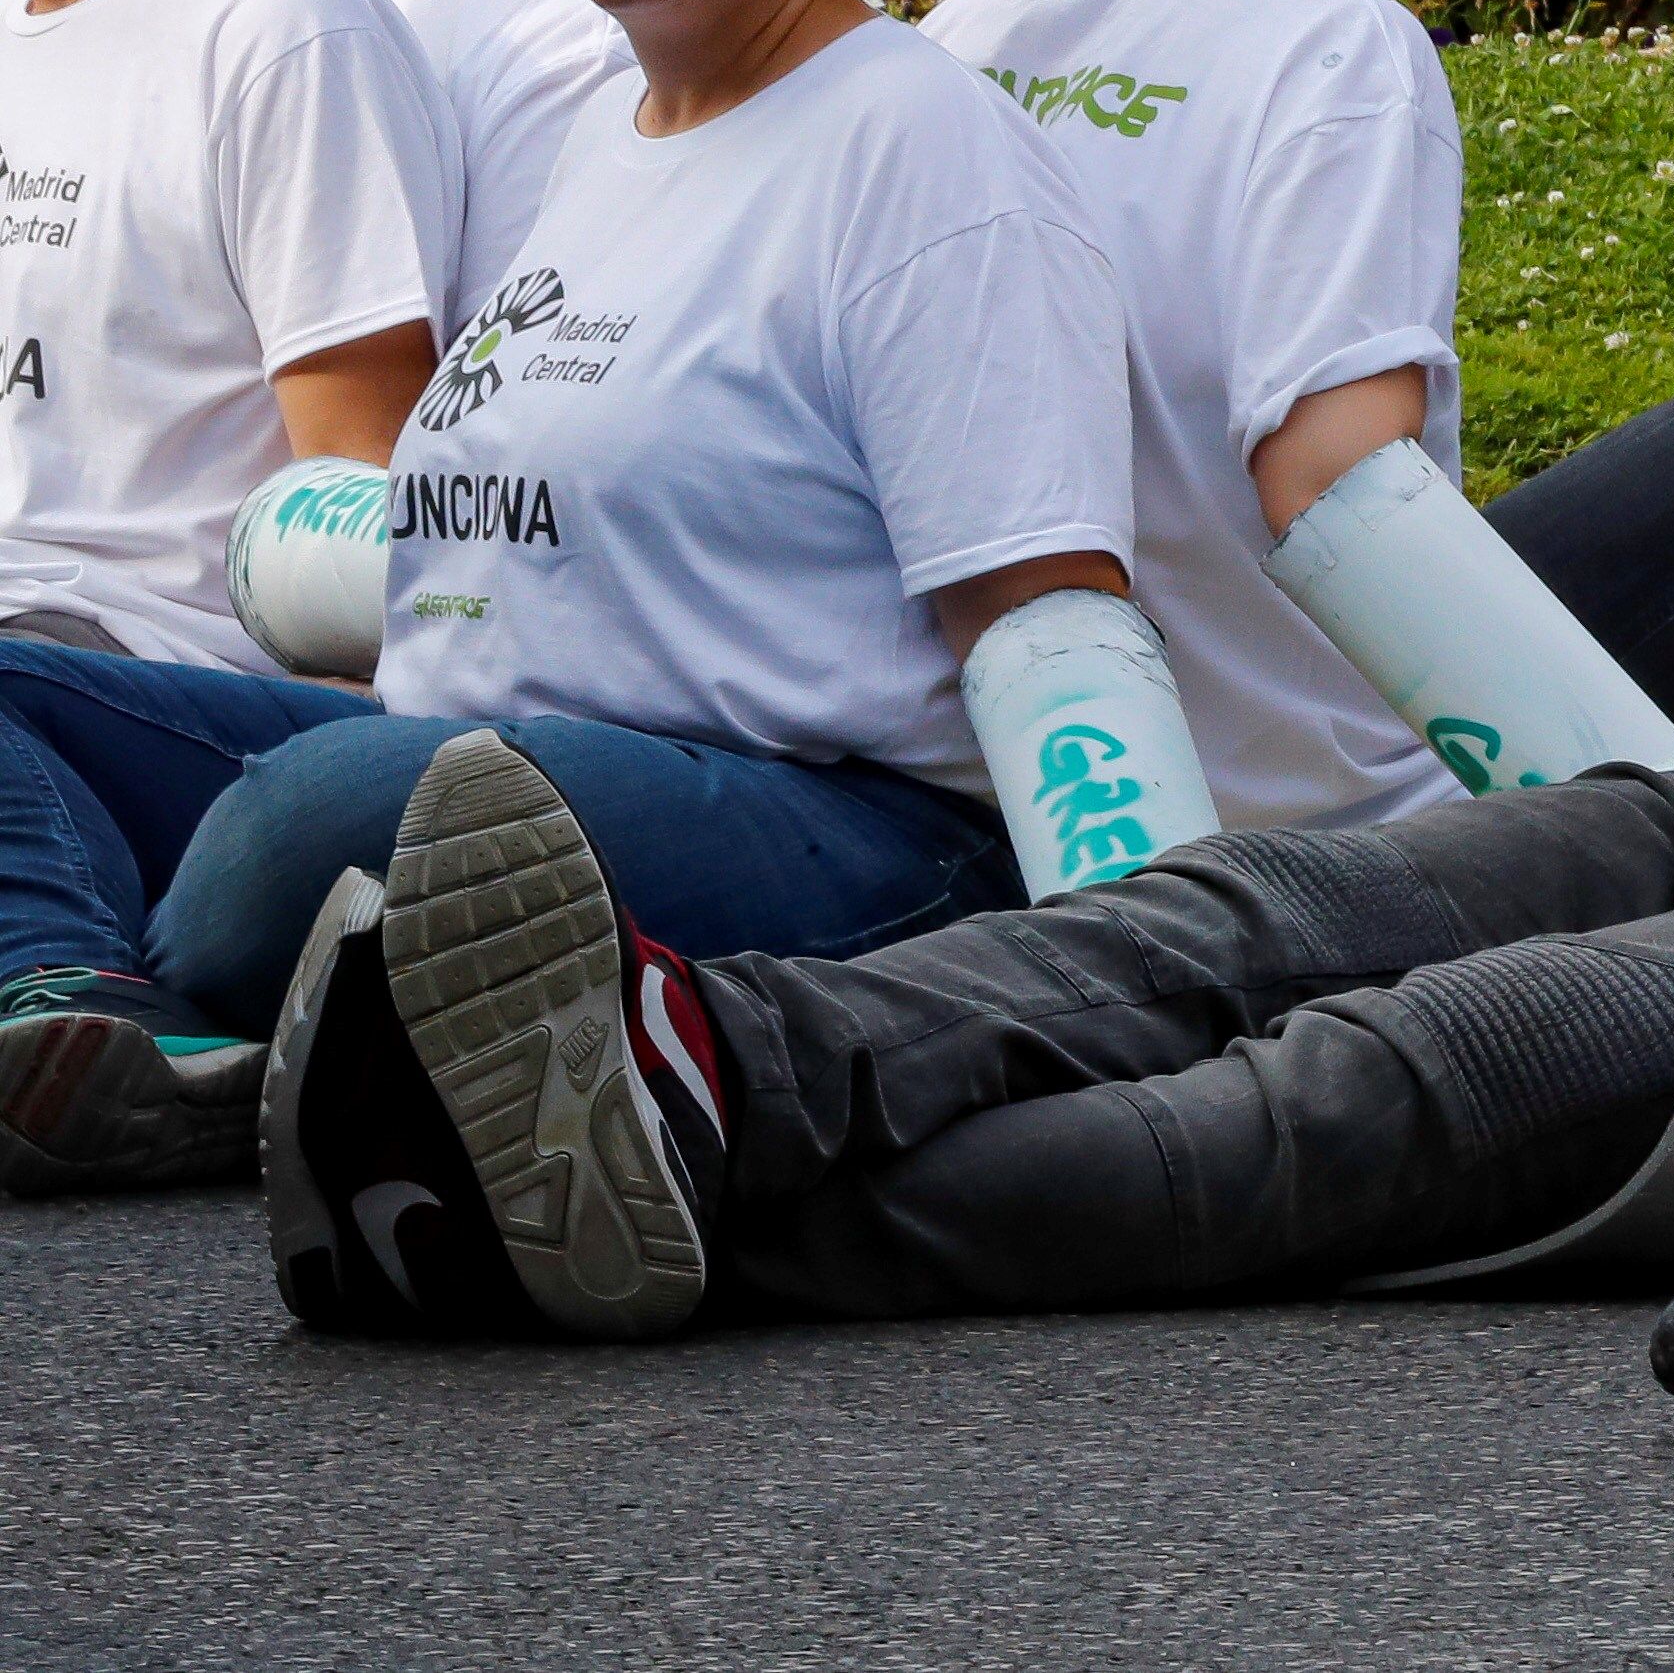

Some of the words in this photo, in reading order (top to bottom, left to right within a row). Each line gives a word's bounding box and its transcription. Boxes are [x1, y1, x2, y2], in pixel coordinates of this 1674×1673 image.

[6, 167, 85, 204] Madrid
[548, 314, 636, 343] Madrid
[521, 353, 616, 384] Central
[391, 473, 559, 547] UNCIONA
